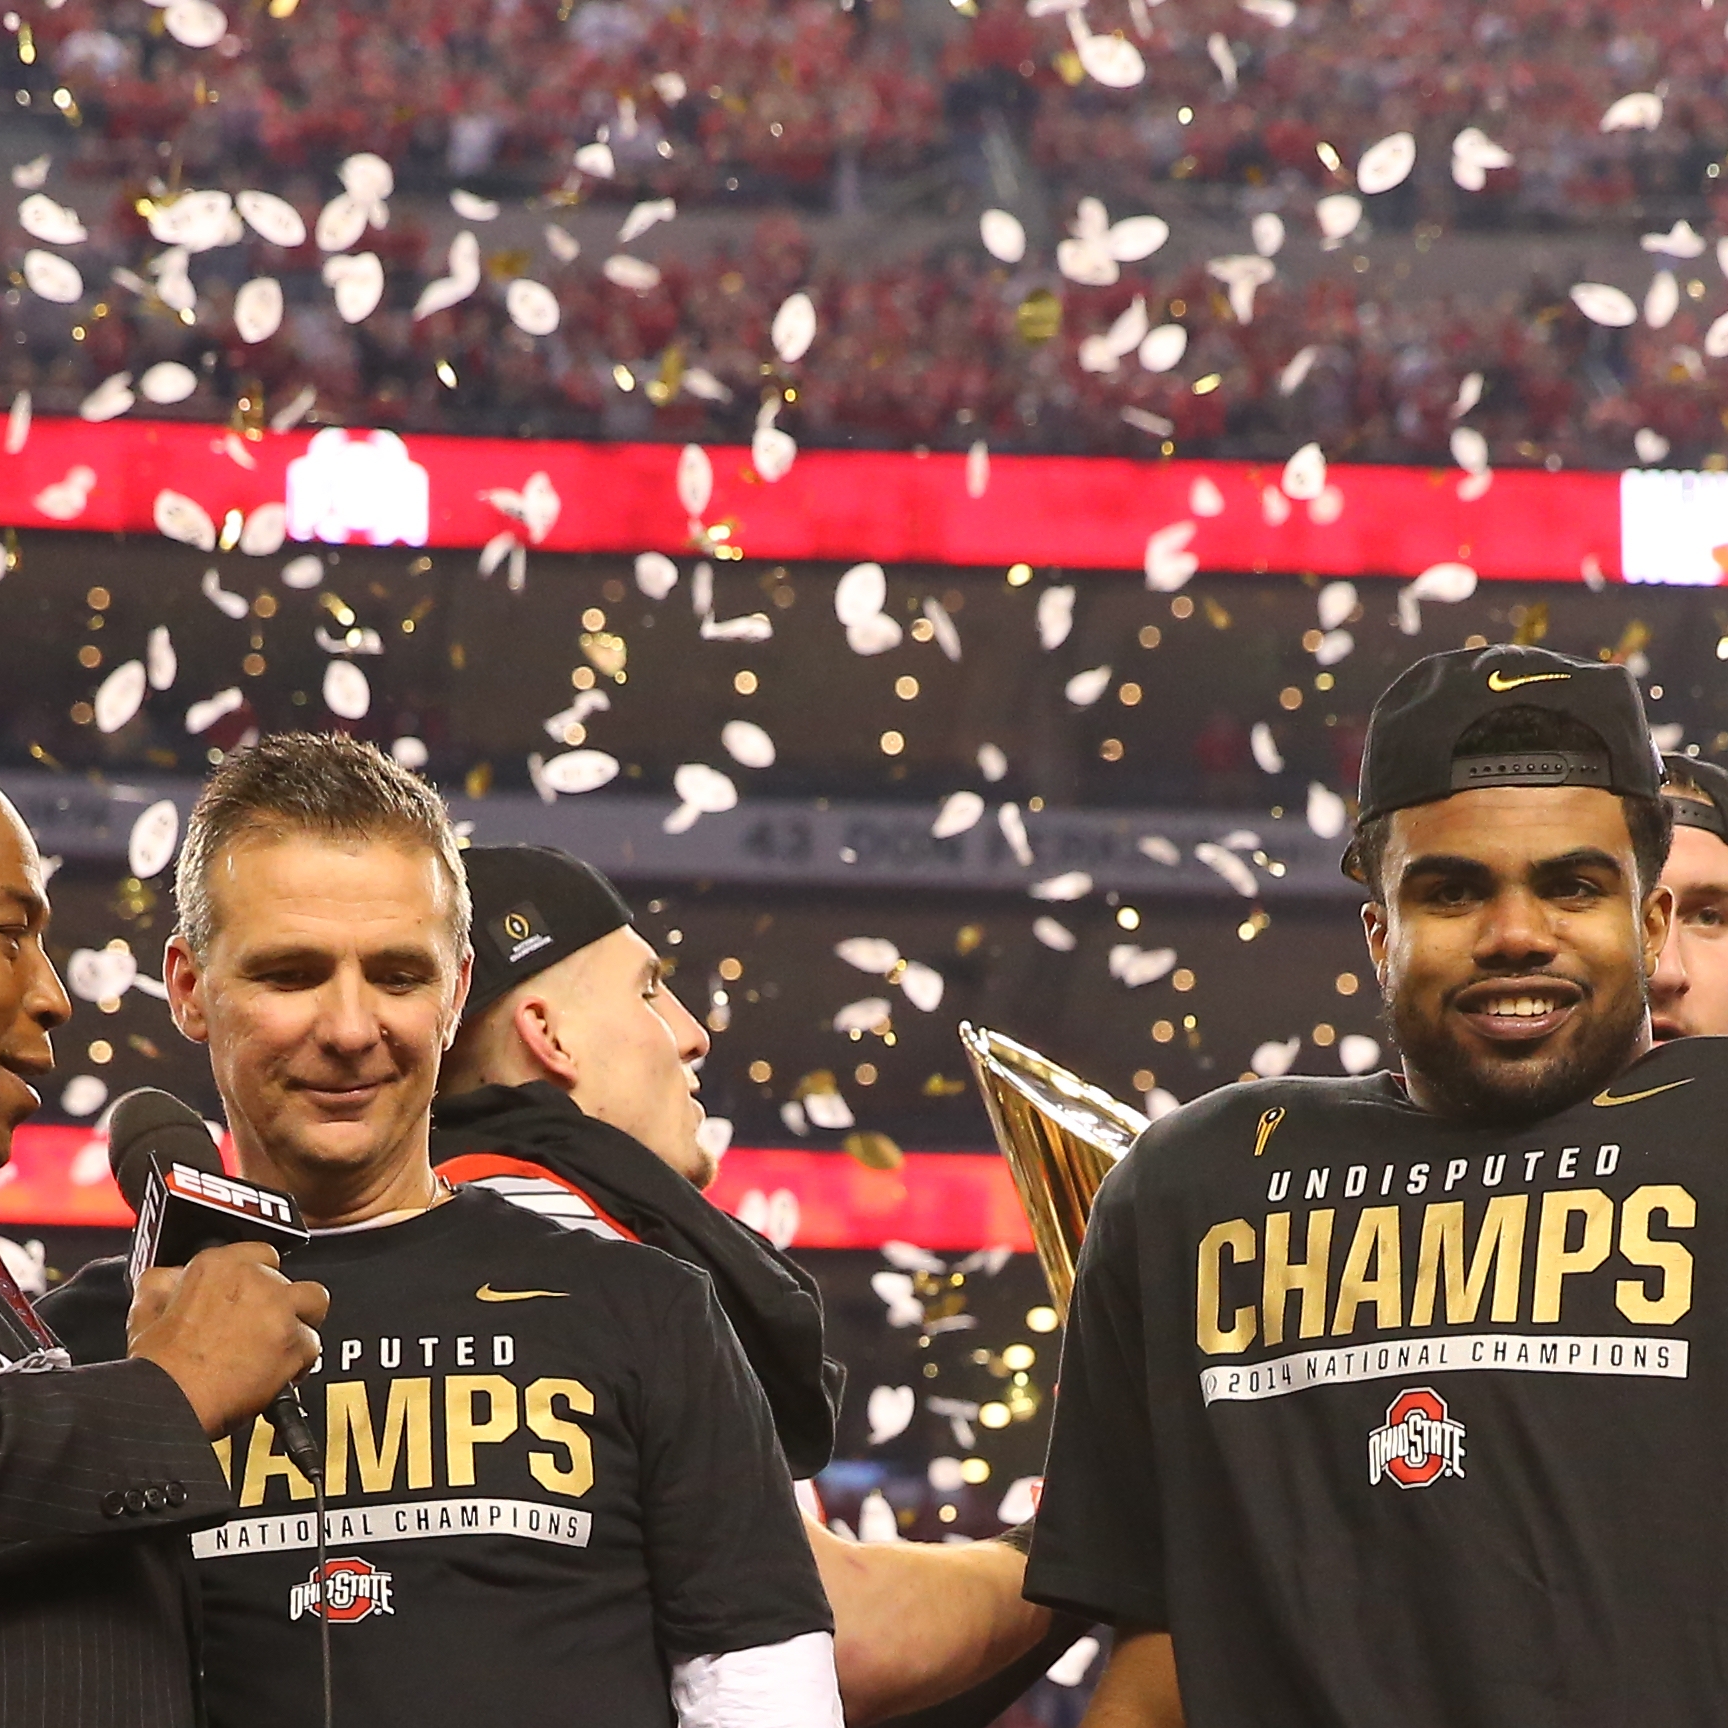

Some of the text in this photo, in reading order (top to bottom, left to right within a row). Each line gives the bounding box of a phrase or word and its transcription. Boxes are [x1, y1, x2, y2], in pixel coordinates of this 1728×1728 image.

[172, 1162, 292, 1224] ESPN
[1267, 1143, 1620, 1202] UNDISPUTED
[1196, 1184, 1696, 1354] CHAMPS
[1228, 1341, 1670, 1394] 2014 NATIONAL CHAMPIONS
[213, 1374, 595, 1507] AMPS
[216, 1505, 579, 1550] NATIONAL CHAMPIONS
